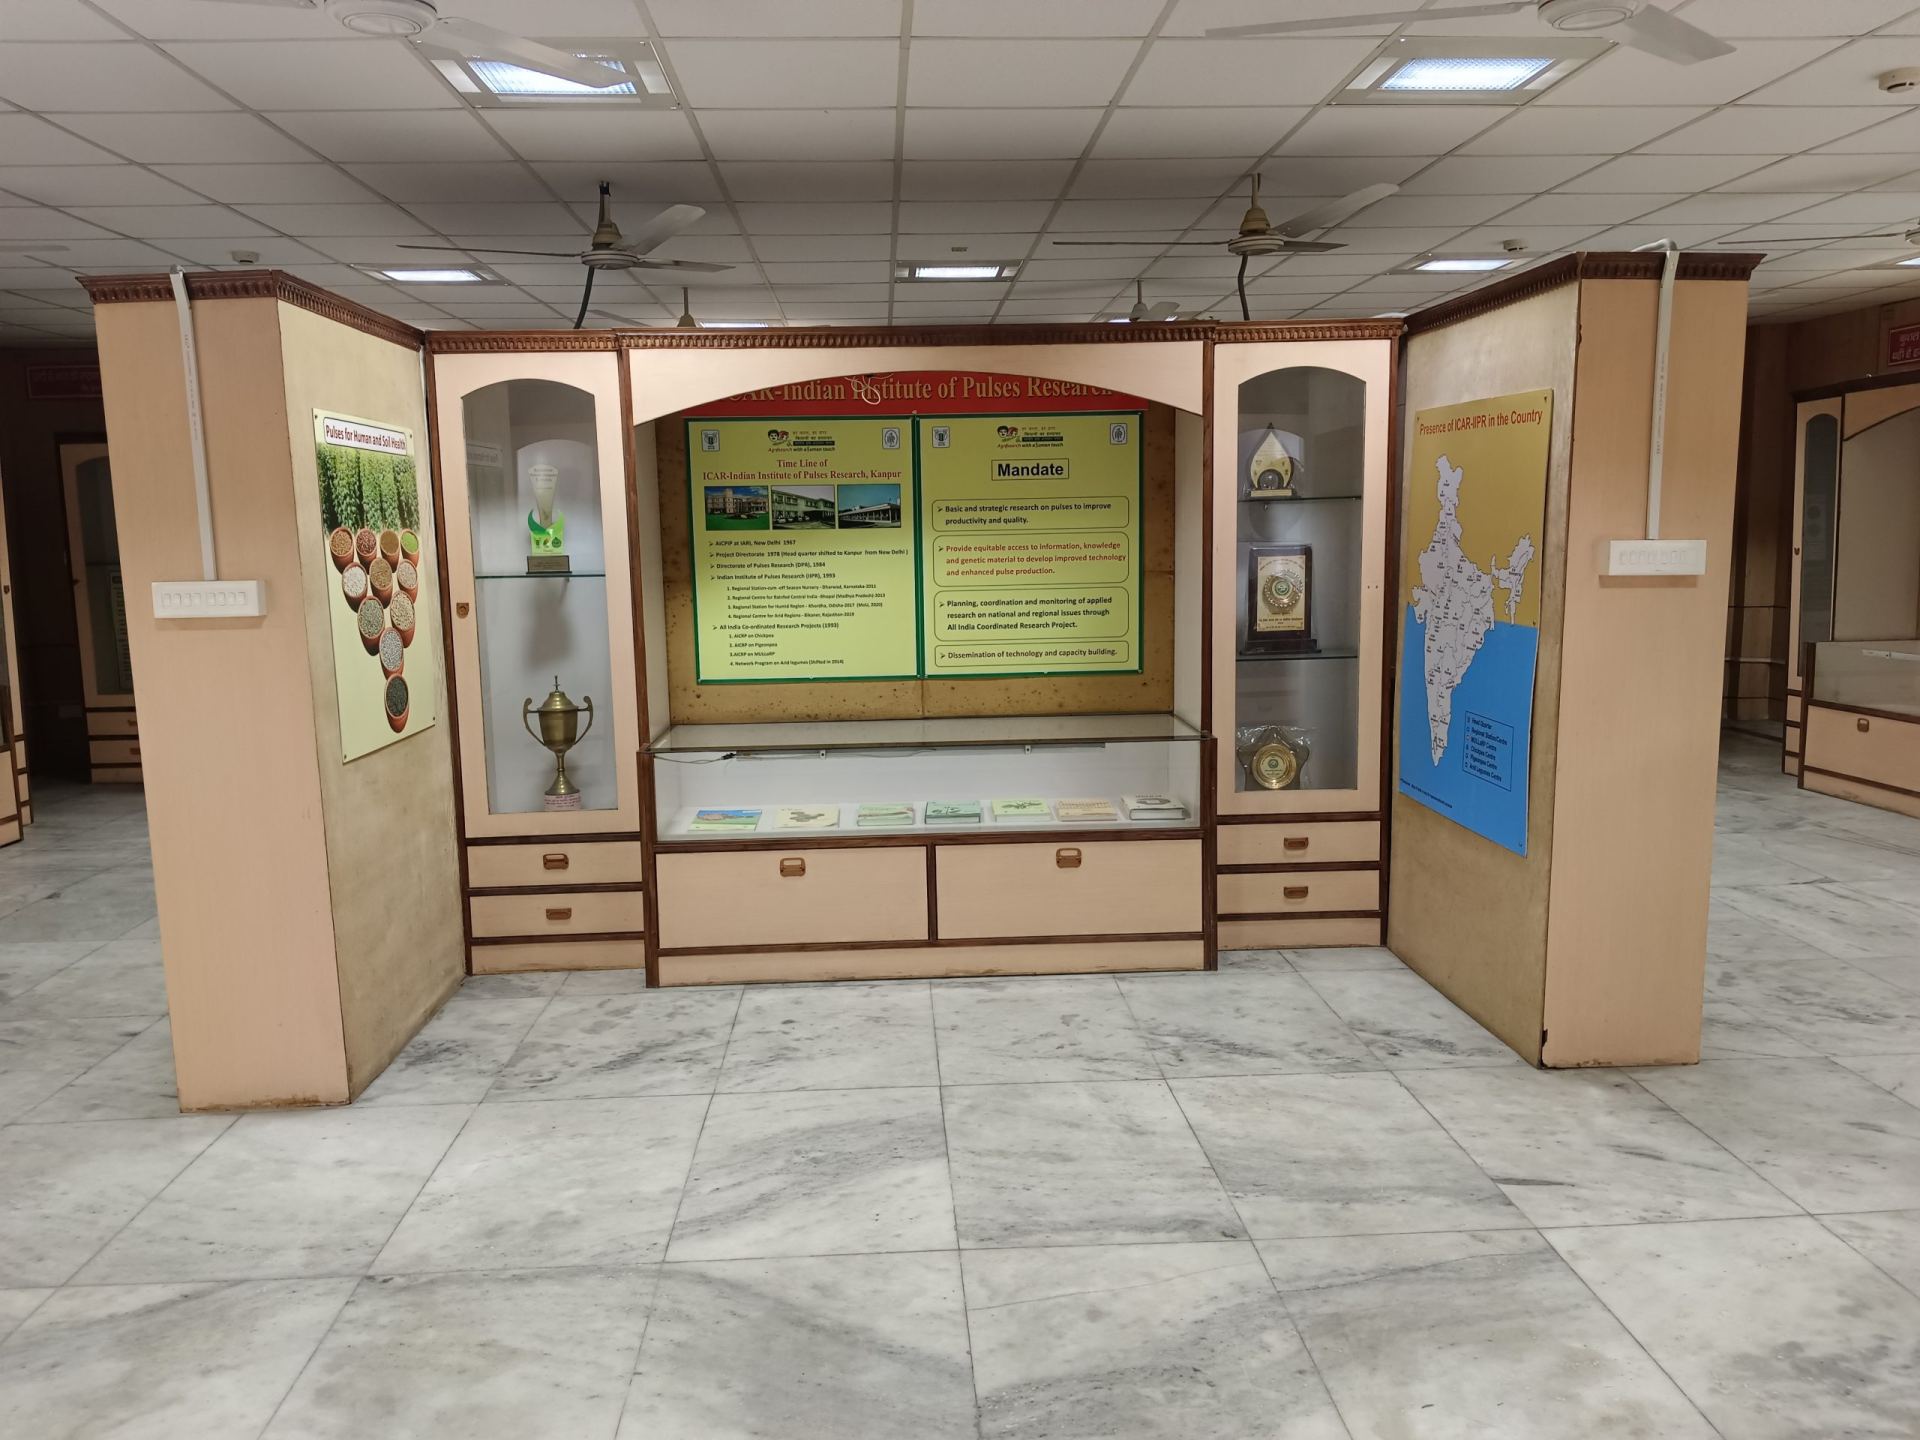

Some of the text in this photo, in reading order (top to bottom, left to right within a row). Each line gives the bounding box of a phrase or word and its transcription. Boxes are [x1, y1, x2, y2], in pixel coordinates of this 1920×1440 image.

[853, 377, 932, 400] Institute
[938, 376, 958, 398] of
[962, 376, 1020, 398] Pulses
[1028, 378, 1112, 396] Researc
[1420, 409, 1543, 436] Presence of ICAR-IIPR in the Country
[326, 424, 406, 450] Pulses for Human and Soil Health
[776, 459, 828, 468] Time Line of
[998, 463, 1064, 476] Mandate
[703, 470, 902, 480] ICAR-Indian Institute of Pulses Research, Kanpur
